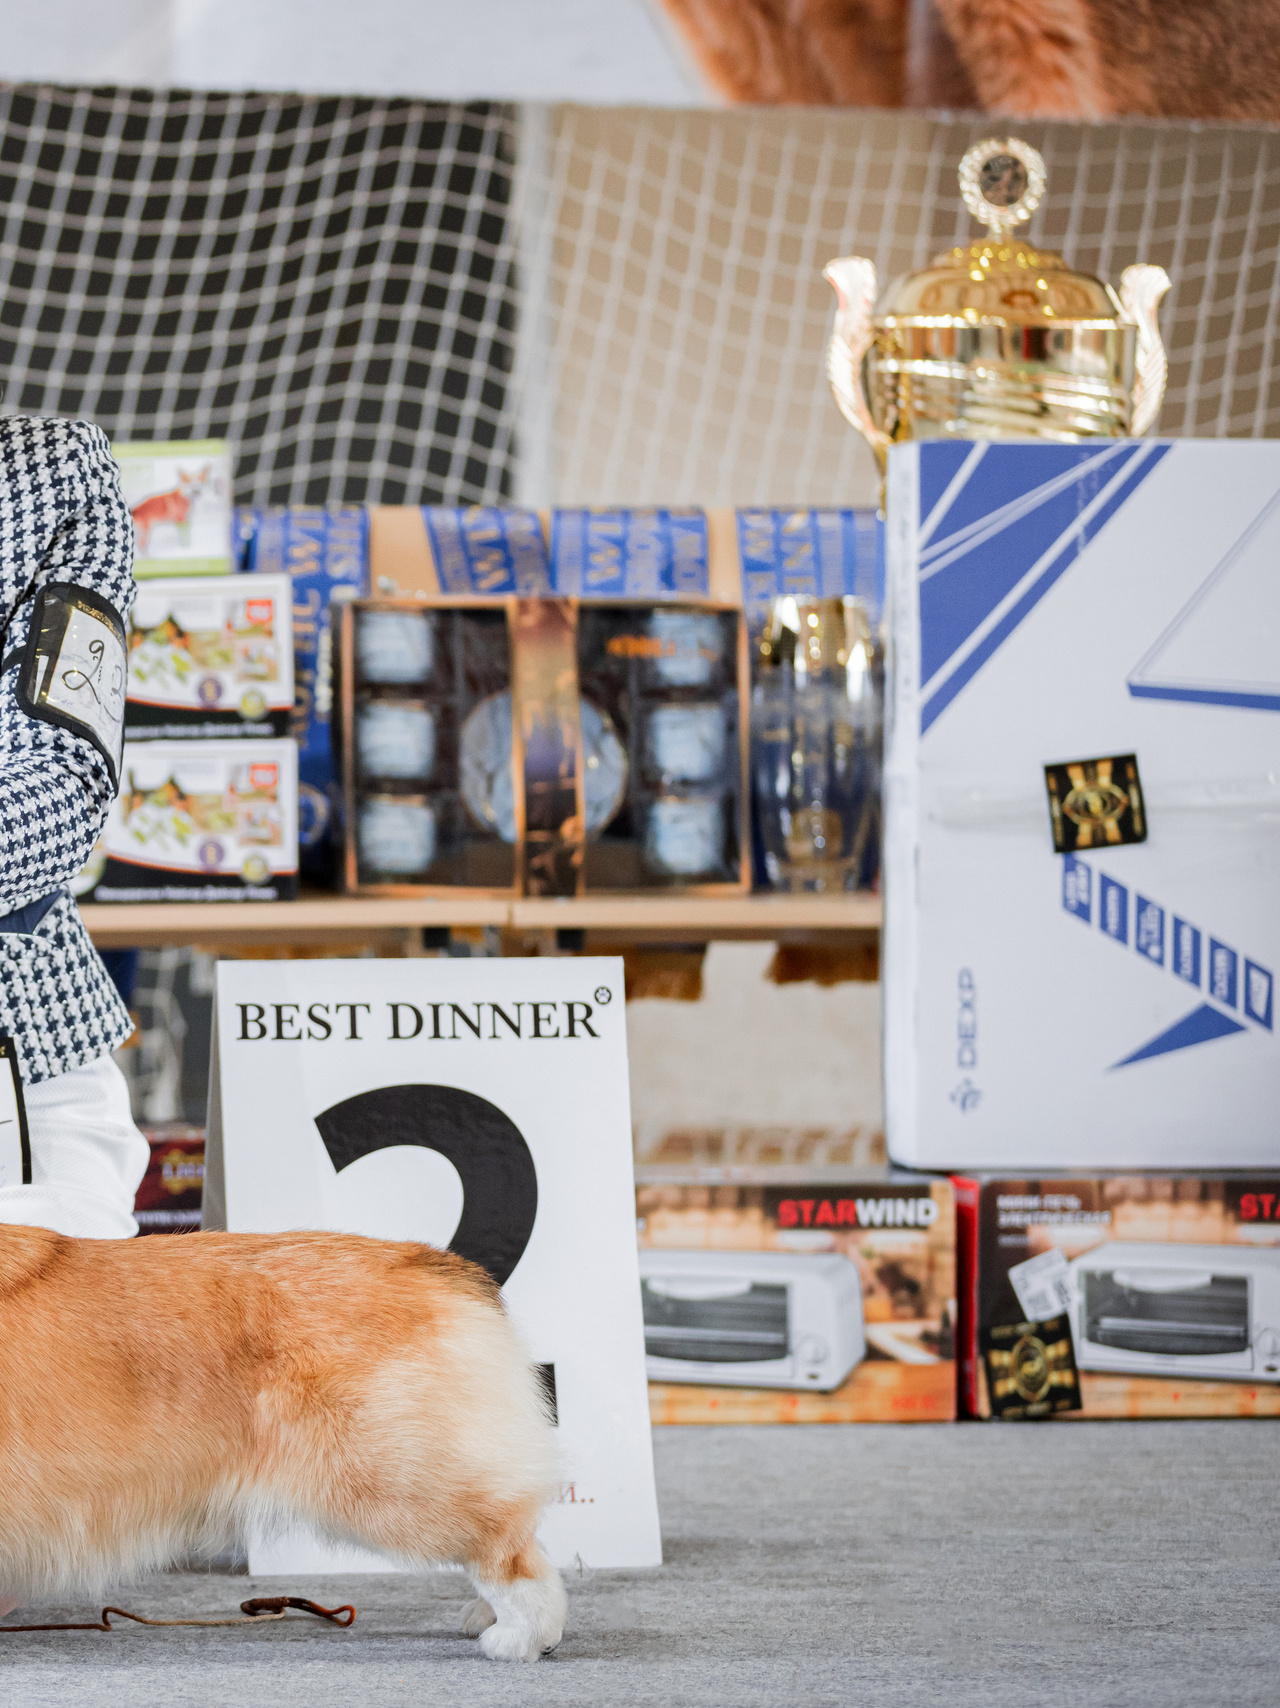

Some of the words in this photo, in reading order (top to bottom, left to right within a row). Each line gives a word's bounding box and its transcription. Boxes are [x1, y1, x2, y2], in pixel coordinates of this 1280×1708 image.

[235, 1002, 371, 1041] BEST
[386, 1001, 601, 1040] DINNER
[957, 967, 977, 1069] DEXP
[777, 1198, 939, 1228] STARWIND
